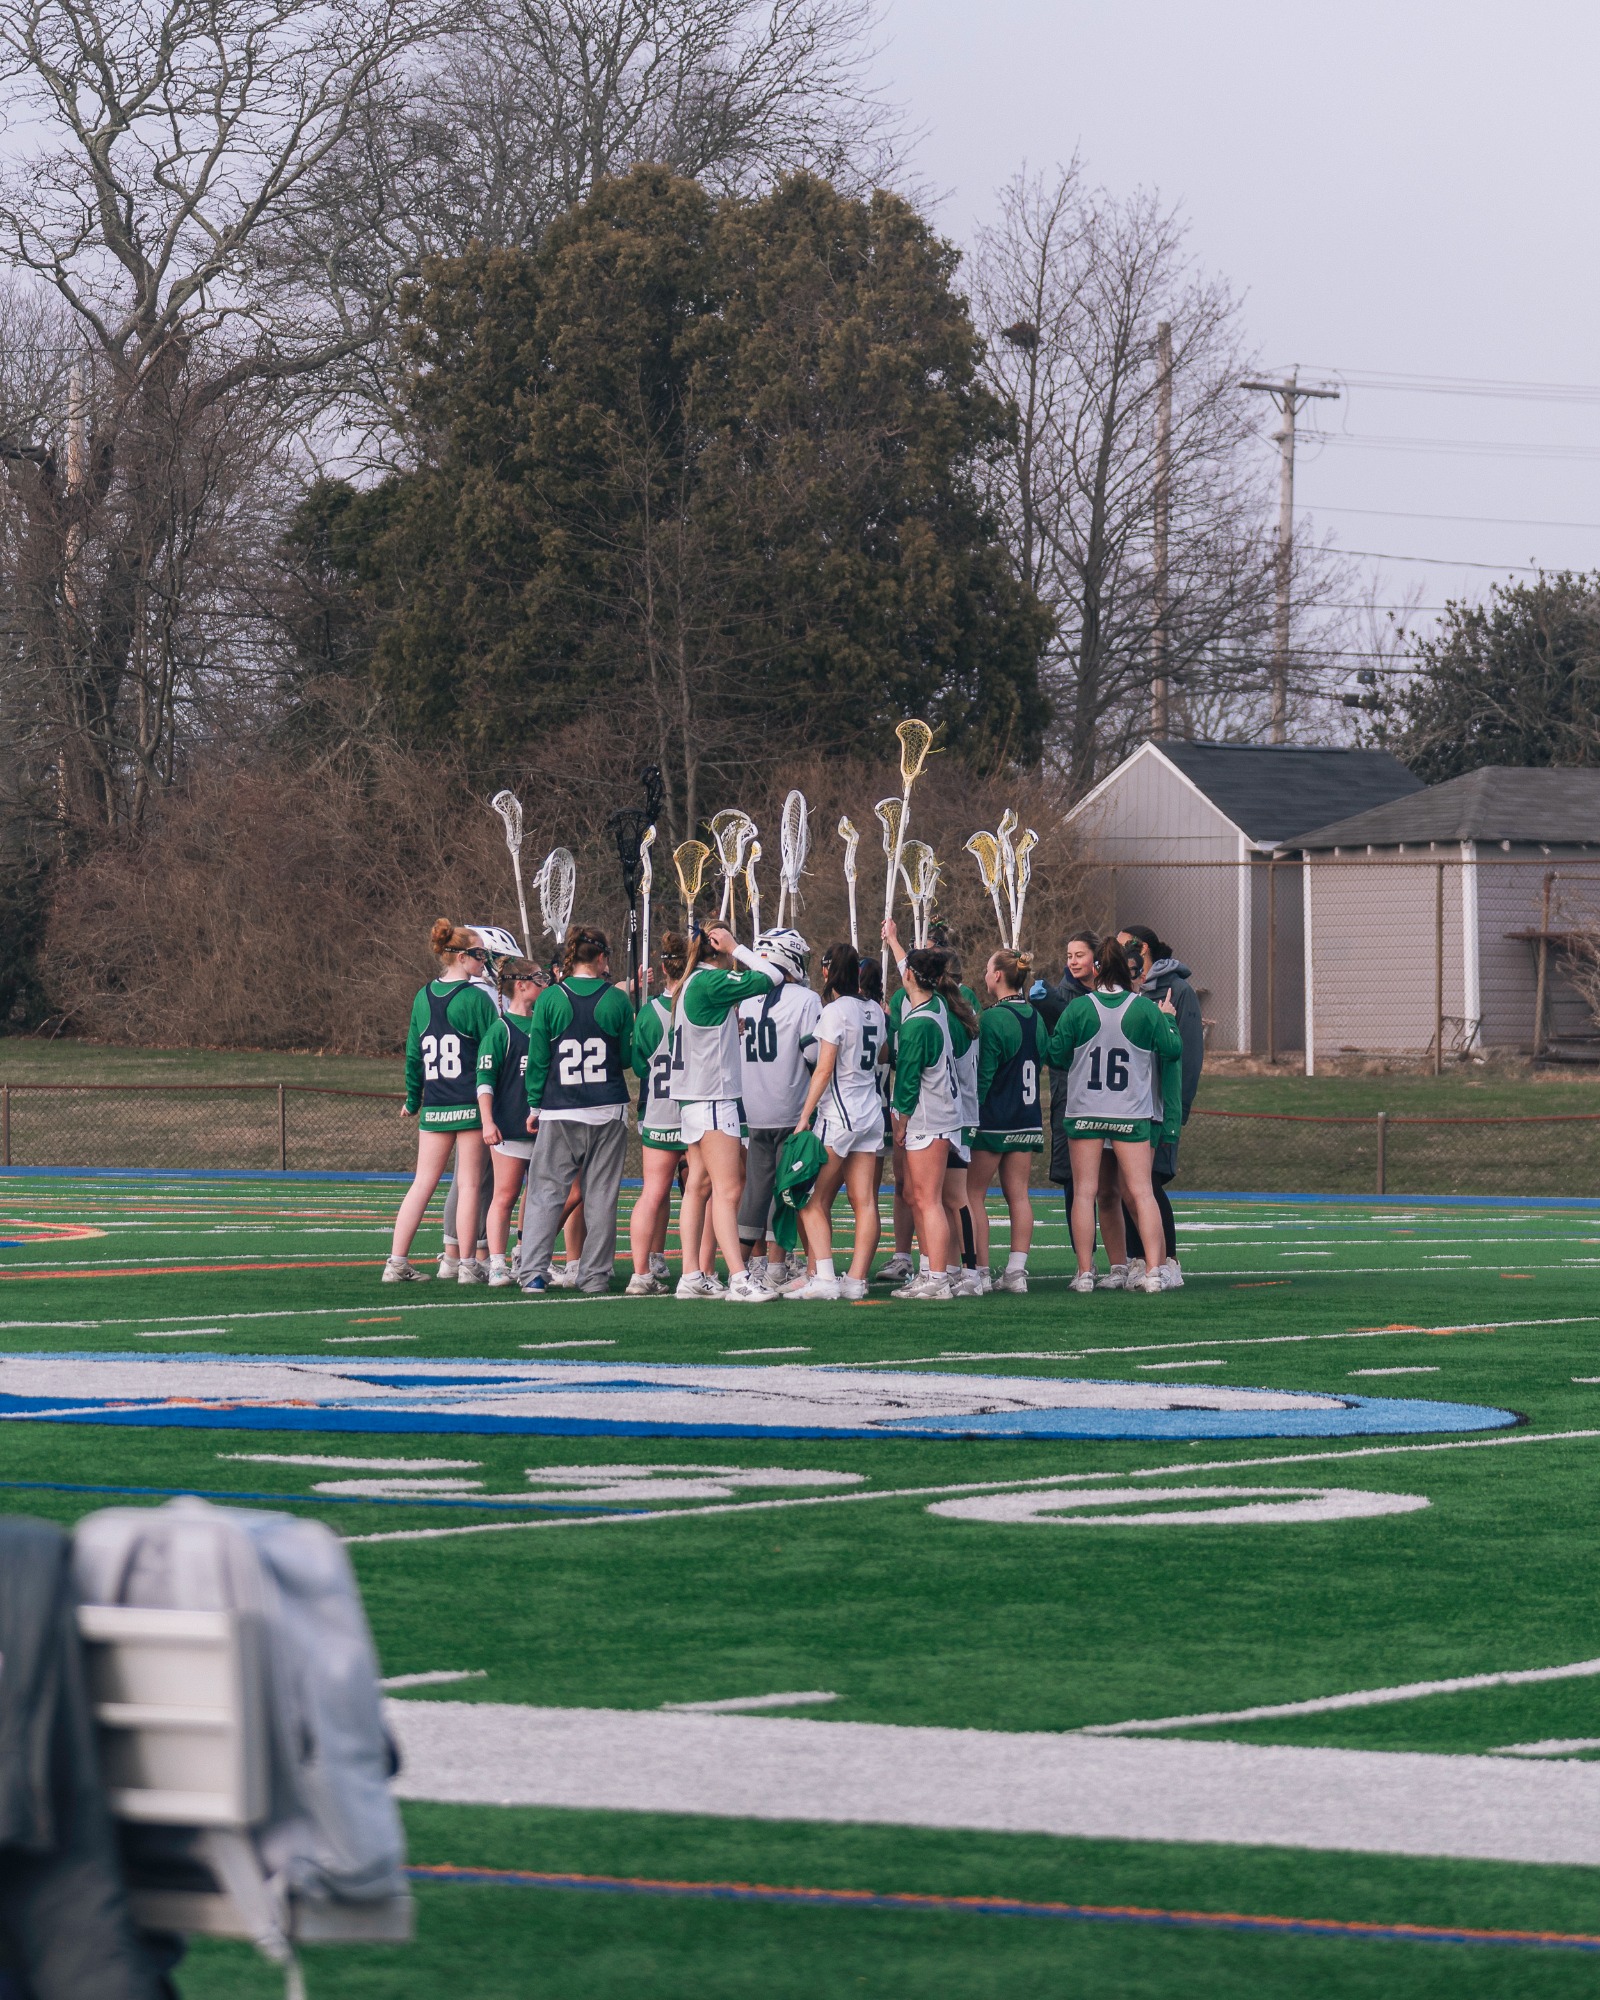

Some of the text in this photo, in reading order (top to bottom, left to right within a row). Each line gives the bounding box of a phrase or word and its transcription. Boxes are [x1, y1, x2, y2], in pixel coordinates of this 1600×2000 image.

[789, 940, 802, 951] 20
[421, 1033, 462, 1081] 28
[478, 1054, 493, 1070] 15
[558, 1037, 607, 1086] 22
[744, 1016, 778, 1063] 20
[860, 1025, 878, 1071] 5
[1022, 1059, 1037, 1105] 9
[1086, 1046, 1130, 1093] 16
[424, 1108, 477, 1123] SEAHAWKS
[649, 1130, 682, 1142] SEAHA
[1075, 1120, 1134, 1135] SEAHAWKS
